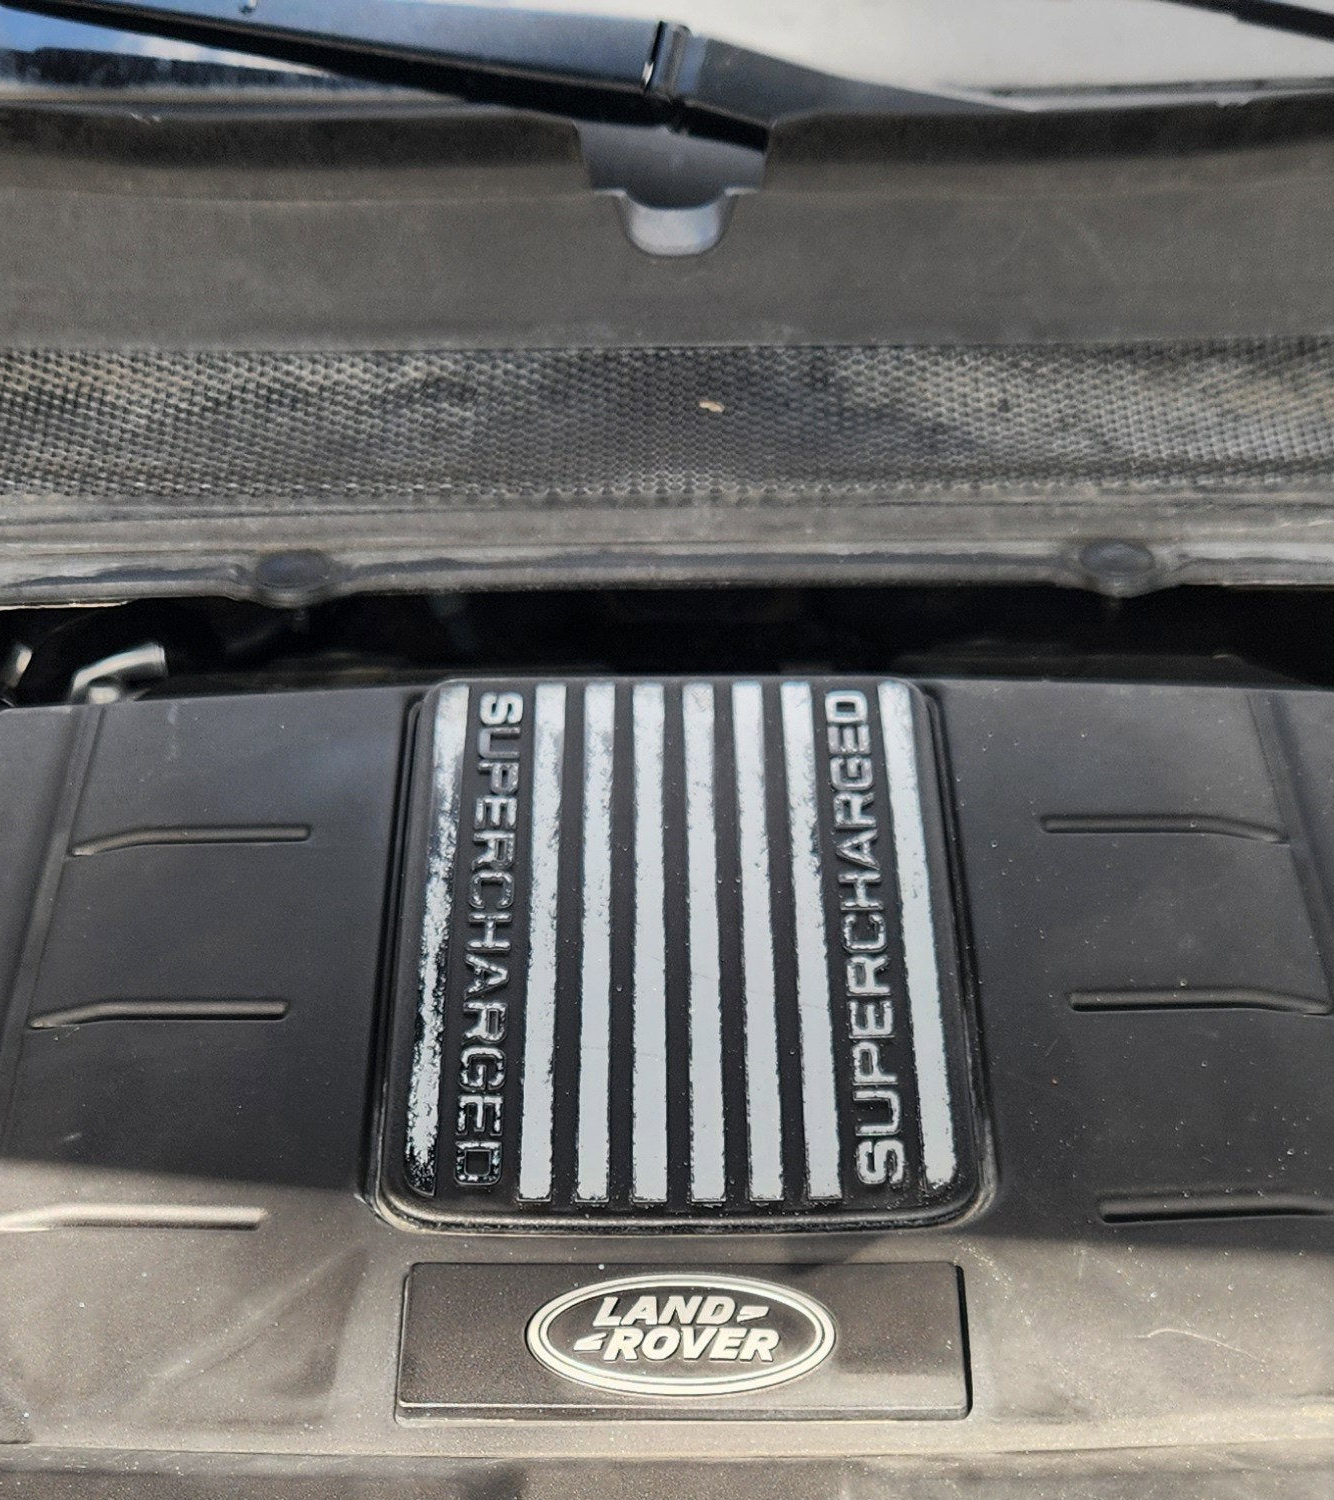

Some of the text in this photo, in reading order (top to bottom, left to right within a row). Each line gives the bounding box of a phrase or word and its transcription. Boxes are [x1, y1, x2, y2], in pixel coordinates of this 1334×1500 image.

[456, 690, 524, 1188] SUPERCHARGED
[824, 689, 904, 1187] SUPERCHARGED
[592, 1295, 725, 1329] LAND
[604, 1327, 782, 1363] ROVER
